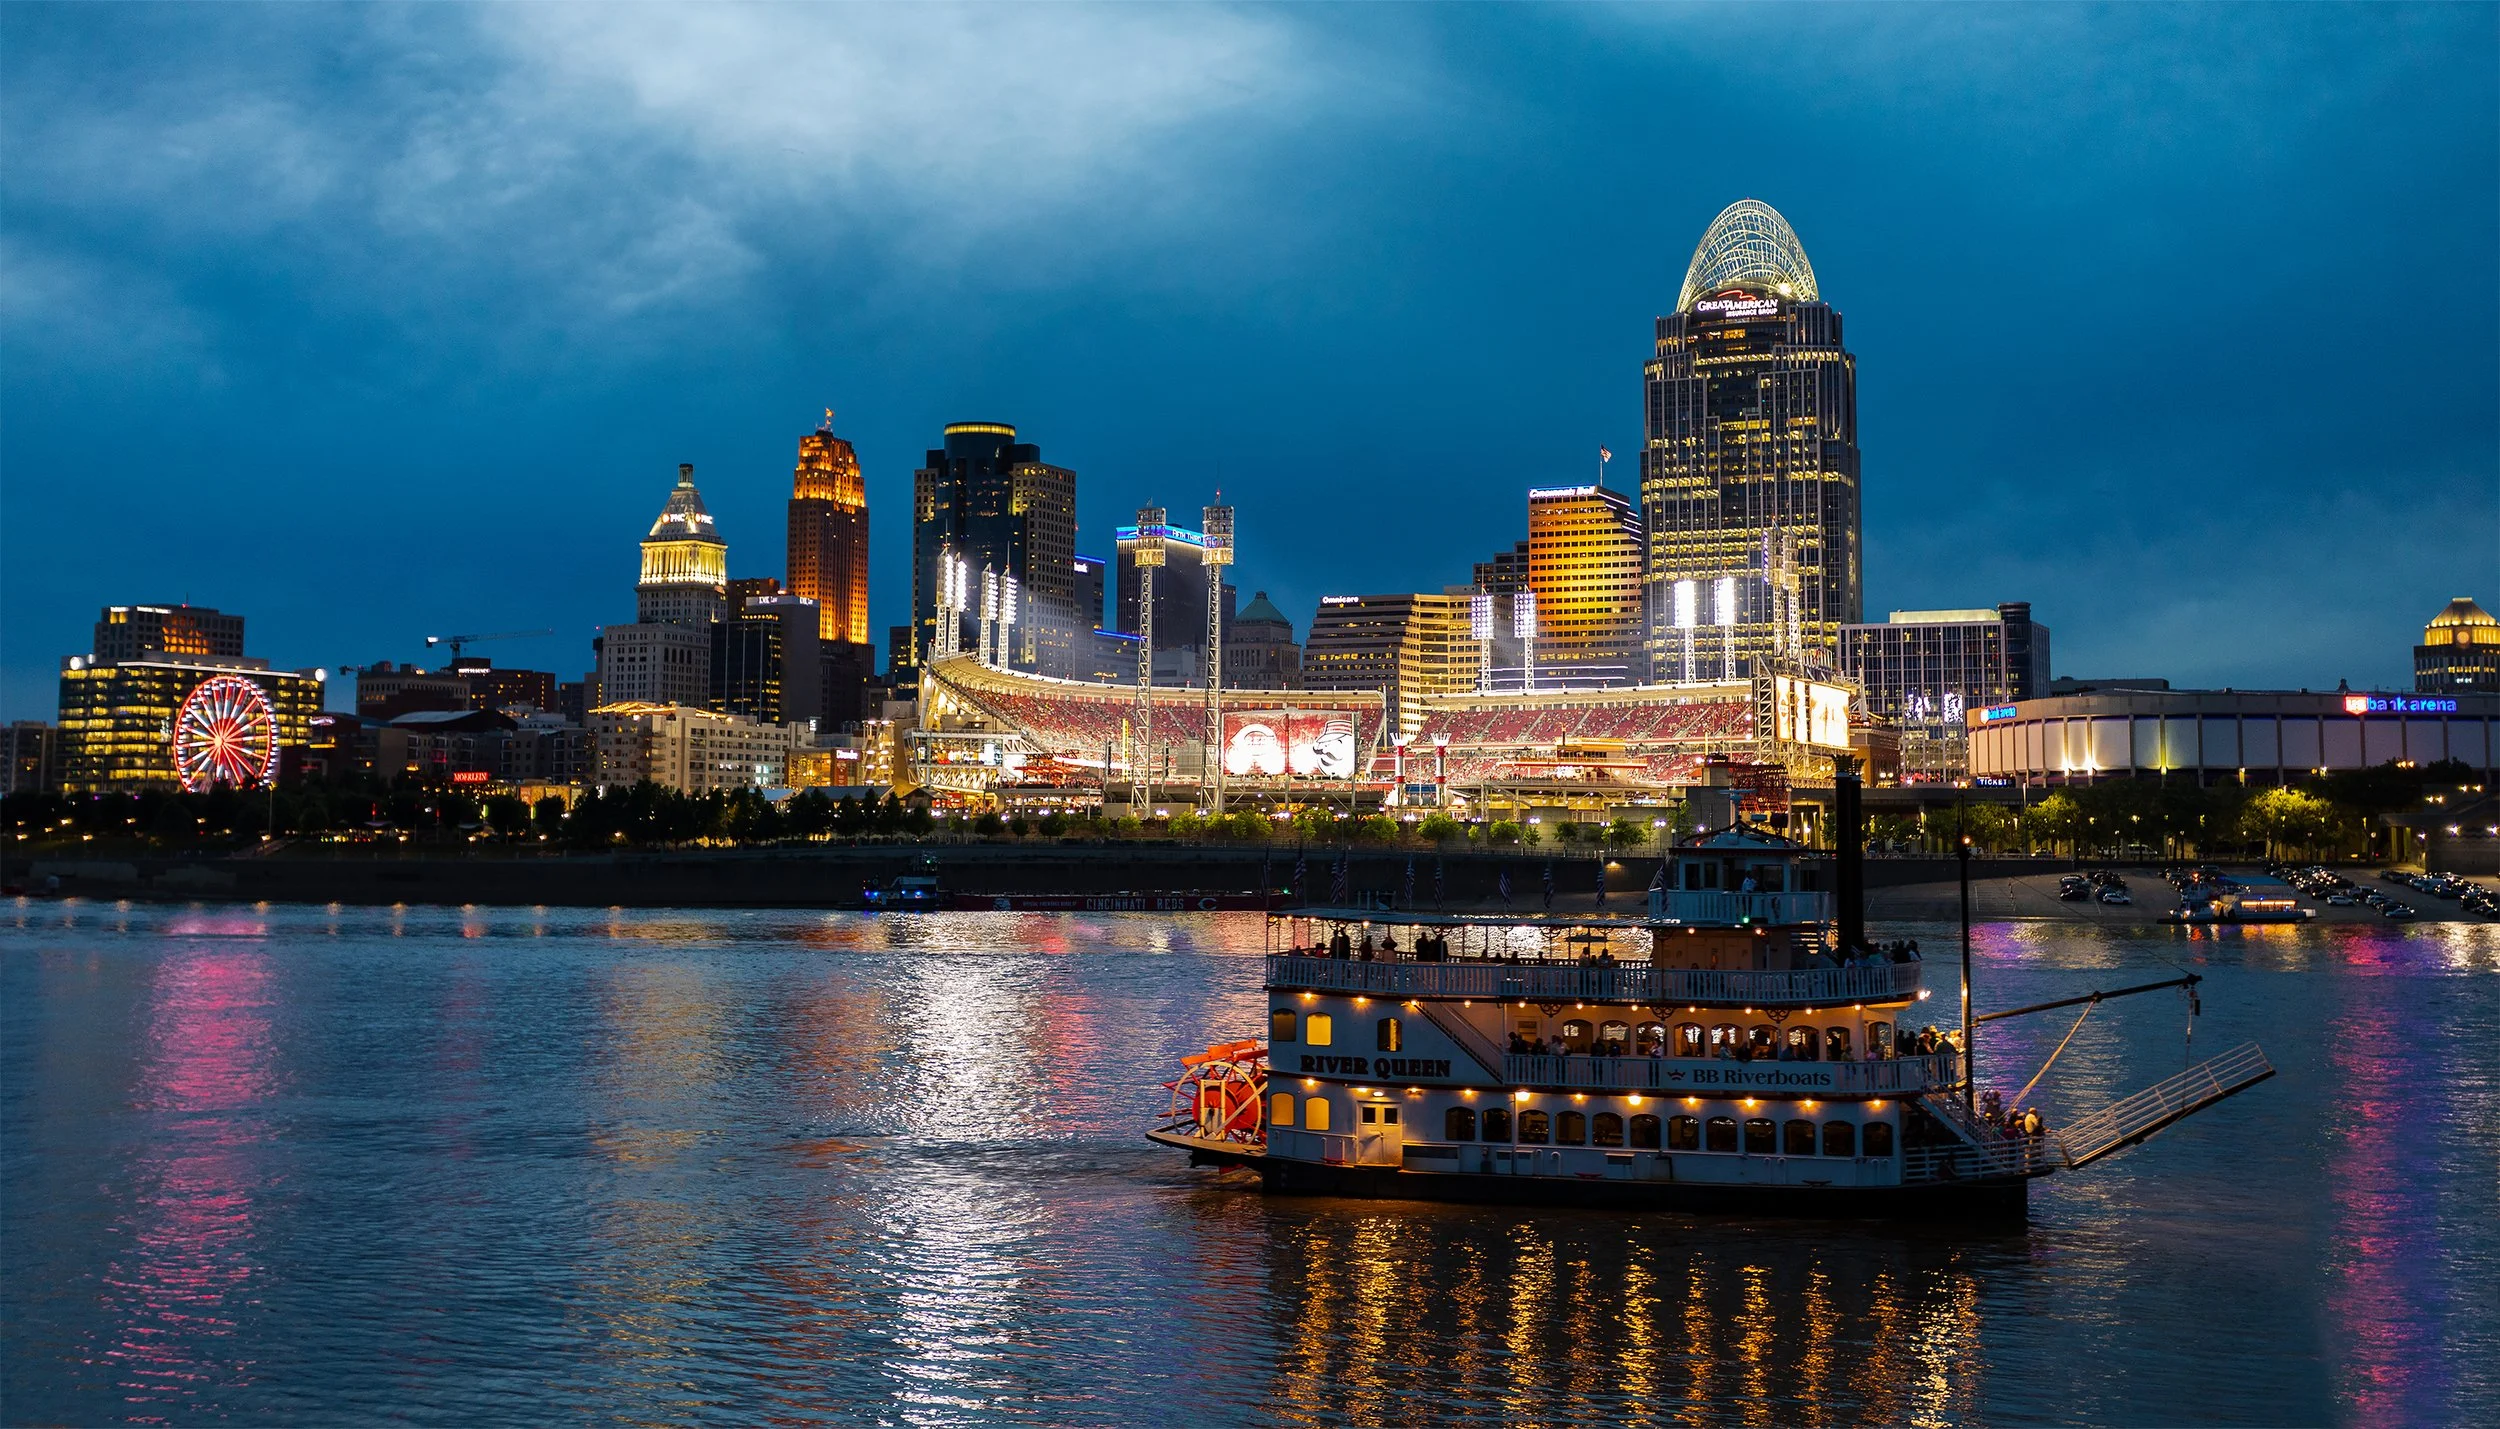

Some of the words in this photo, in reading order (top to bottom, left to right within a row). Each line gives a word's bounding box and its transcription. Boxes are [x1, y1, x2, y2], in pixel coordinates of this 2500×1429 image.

[2367, 697, 2408, 711] bank
[2410, 700, 2457, 711] arena
[454, 772, 488, 782] MOERLEIN
[1157, 898, 1184, 910] REDS
[1301, 1055, 1368, 1075] RIVER
[1374, 1058, 1450, 1079] QUEEN
[1693, 1069, 1719, 1083] BB
[1724, 1069, 1831, 1086] Riverboats
